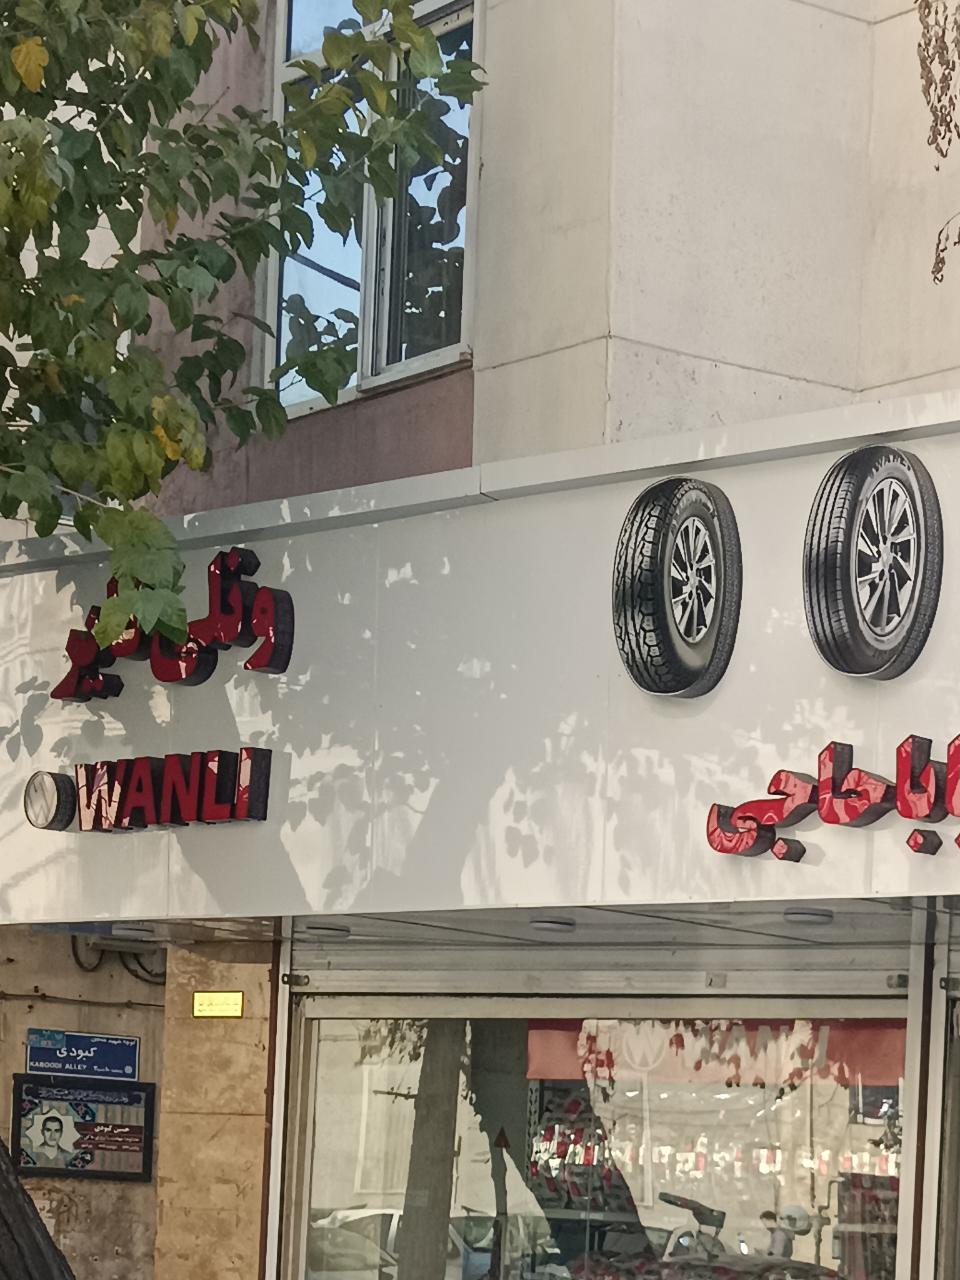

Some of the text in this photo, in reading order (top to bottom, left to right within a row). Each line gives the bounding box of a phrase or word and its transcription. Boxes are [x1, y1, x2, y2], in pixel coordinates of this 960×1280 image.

[75, 747, 272, 832] WANLI
[56, 1046, 98, 1061] کبودی
[64, 1063, 87, 1071] ALLEY
